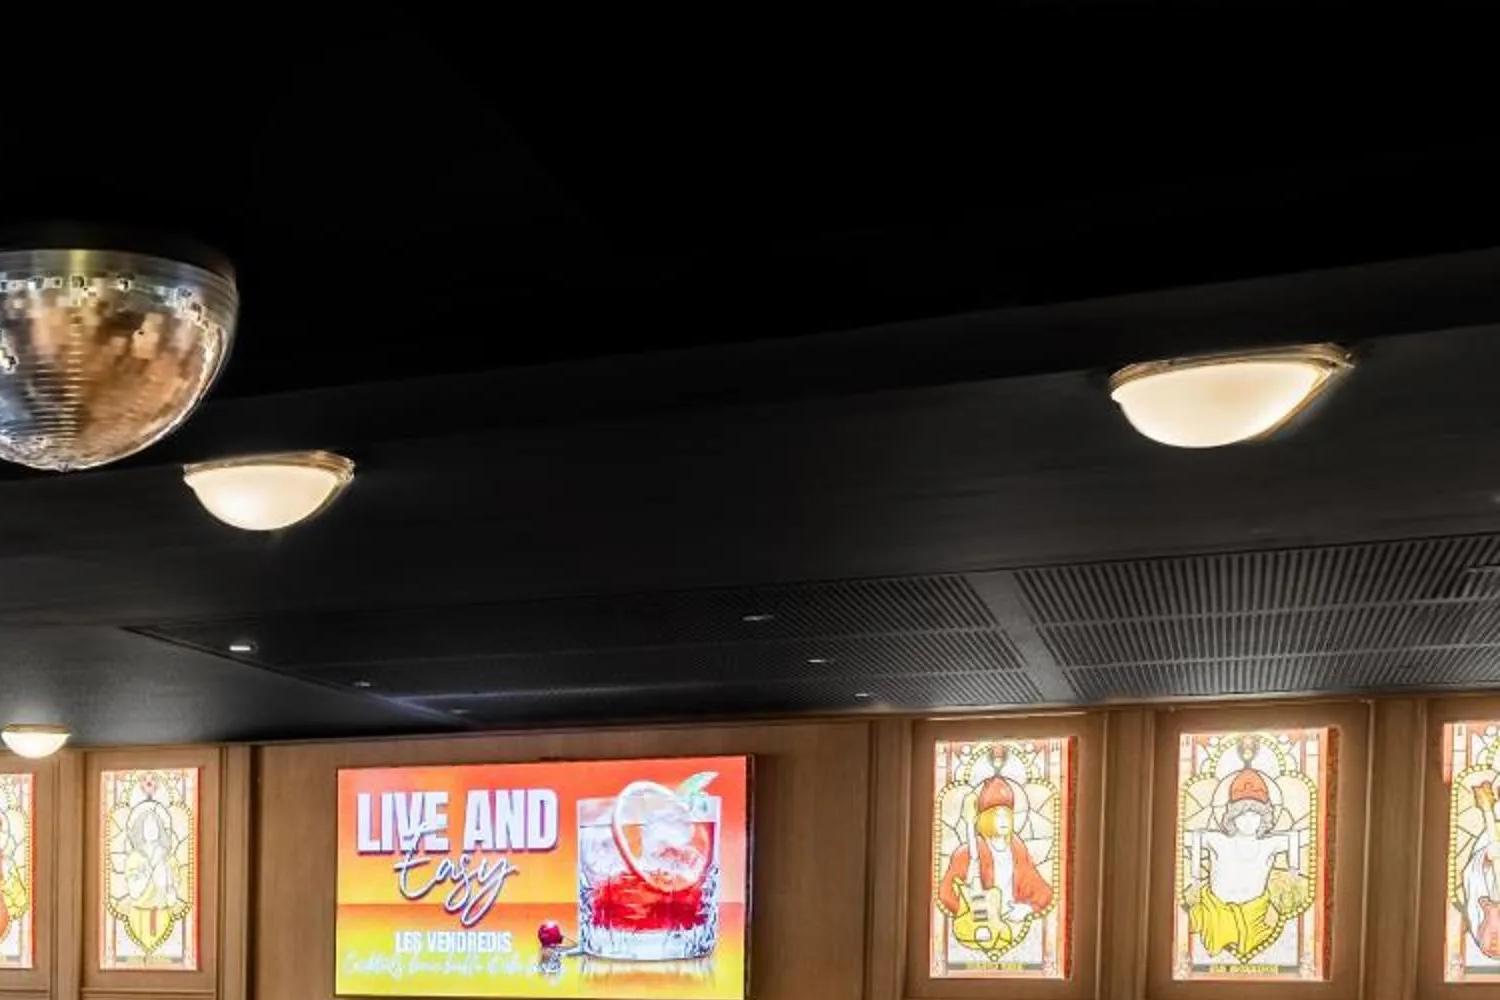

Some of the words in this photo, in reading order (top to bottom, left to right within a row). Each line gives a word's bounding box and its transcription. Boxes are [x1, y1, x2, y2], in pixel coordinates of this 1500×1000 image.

[357, 791, 450, 853] LIVE
[463, 789, 559, 852] AND
[395, 821, 518, 926] Easy
[396, 931, 422, 953] LES
[427, 931, 512, 953] VENDREDIS
